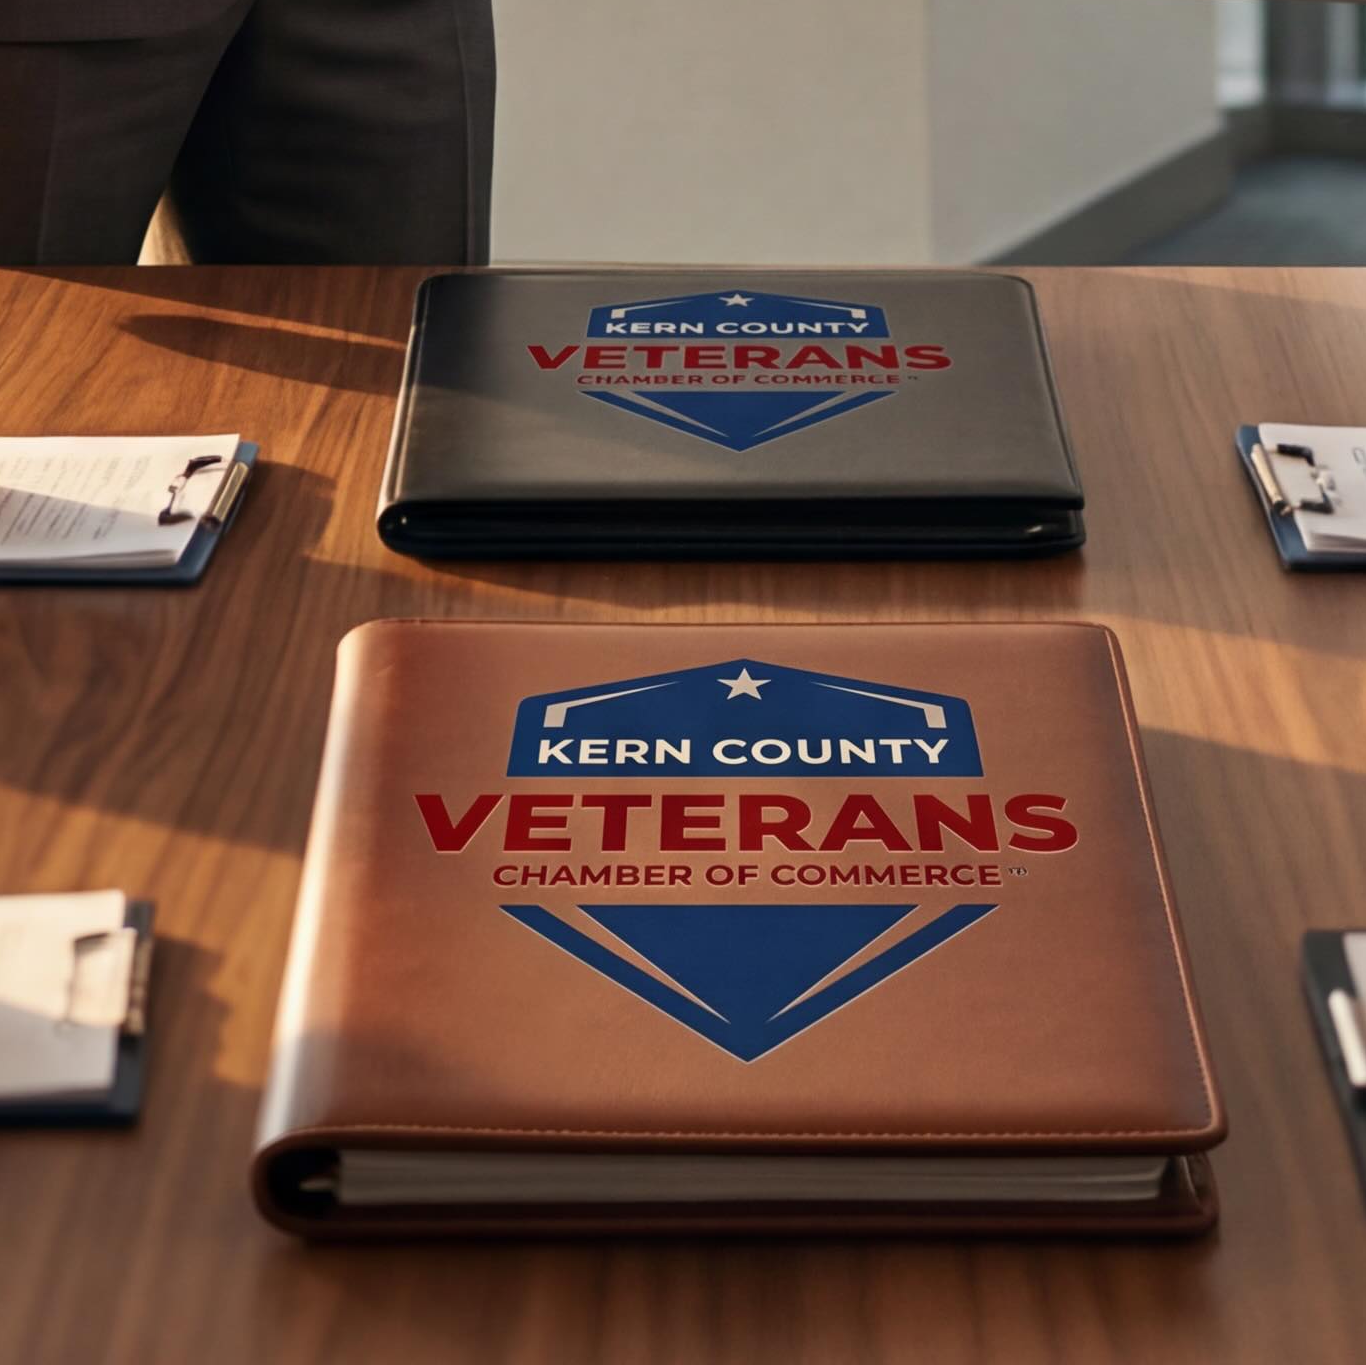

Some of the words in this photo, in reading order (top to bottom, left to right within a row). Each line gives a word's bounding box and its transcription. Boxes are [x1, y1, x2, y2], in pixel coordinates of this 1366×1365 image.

[605, 322, 704, 334] KERN
[715, 322, 869, 334] COUNTY
[527, 344, 953, 370] VETERANS
[577, 374, 703, 385] CHAMBER
[711, 374, 746, 385] OF
[754, 374, 900, 385] COMMERCE
[538, 738, 691, 765] KERN
[712, 738, 949, 765] COUNTY
[414, 794, 1080, 854] VETERANS
[492, 864, 692, 887] CHAMBER
[705, 864, 759, 887] OF
[770, 864, 1003, 887] COMMERCE
